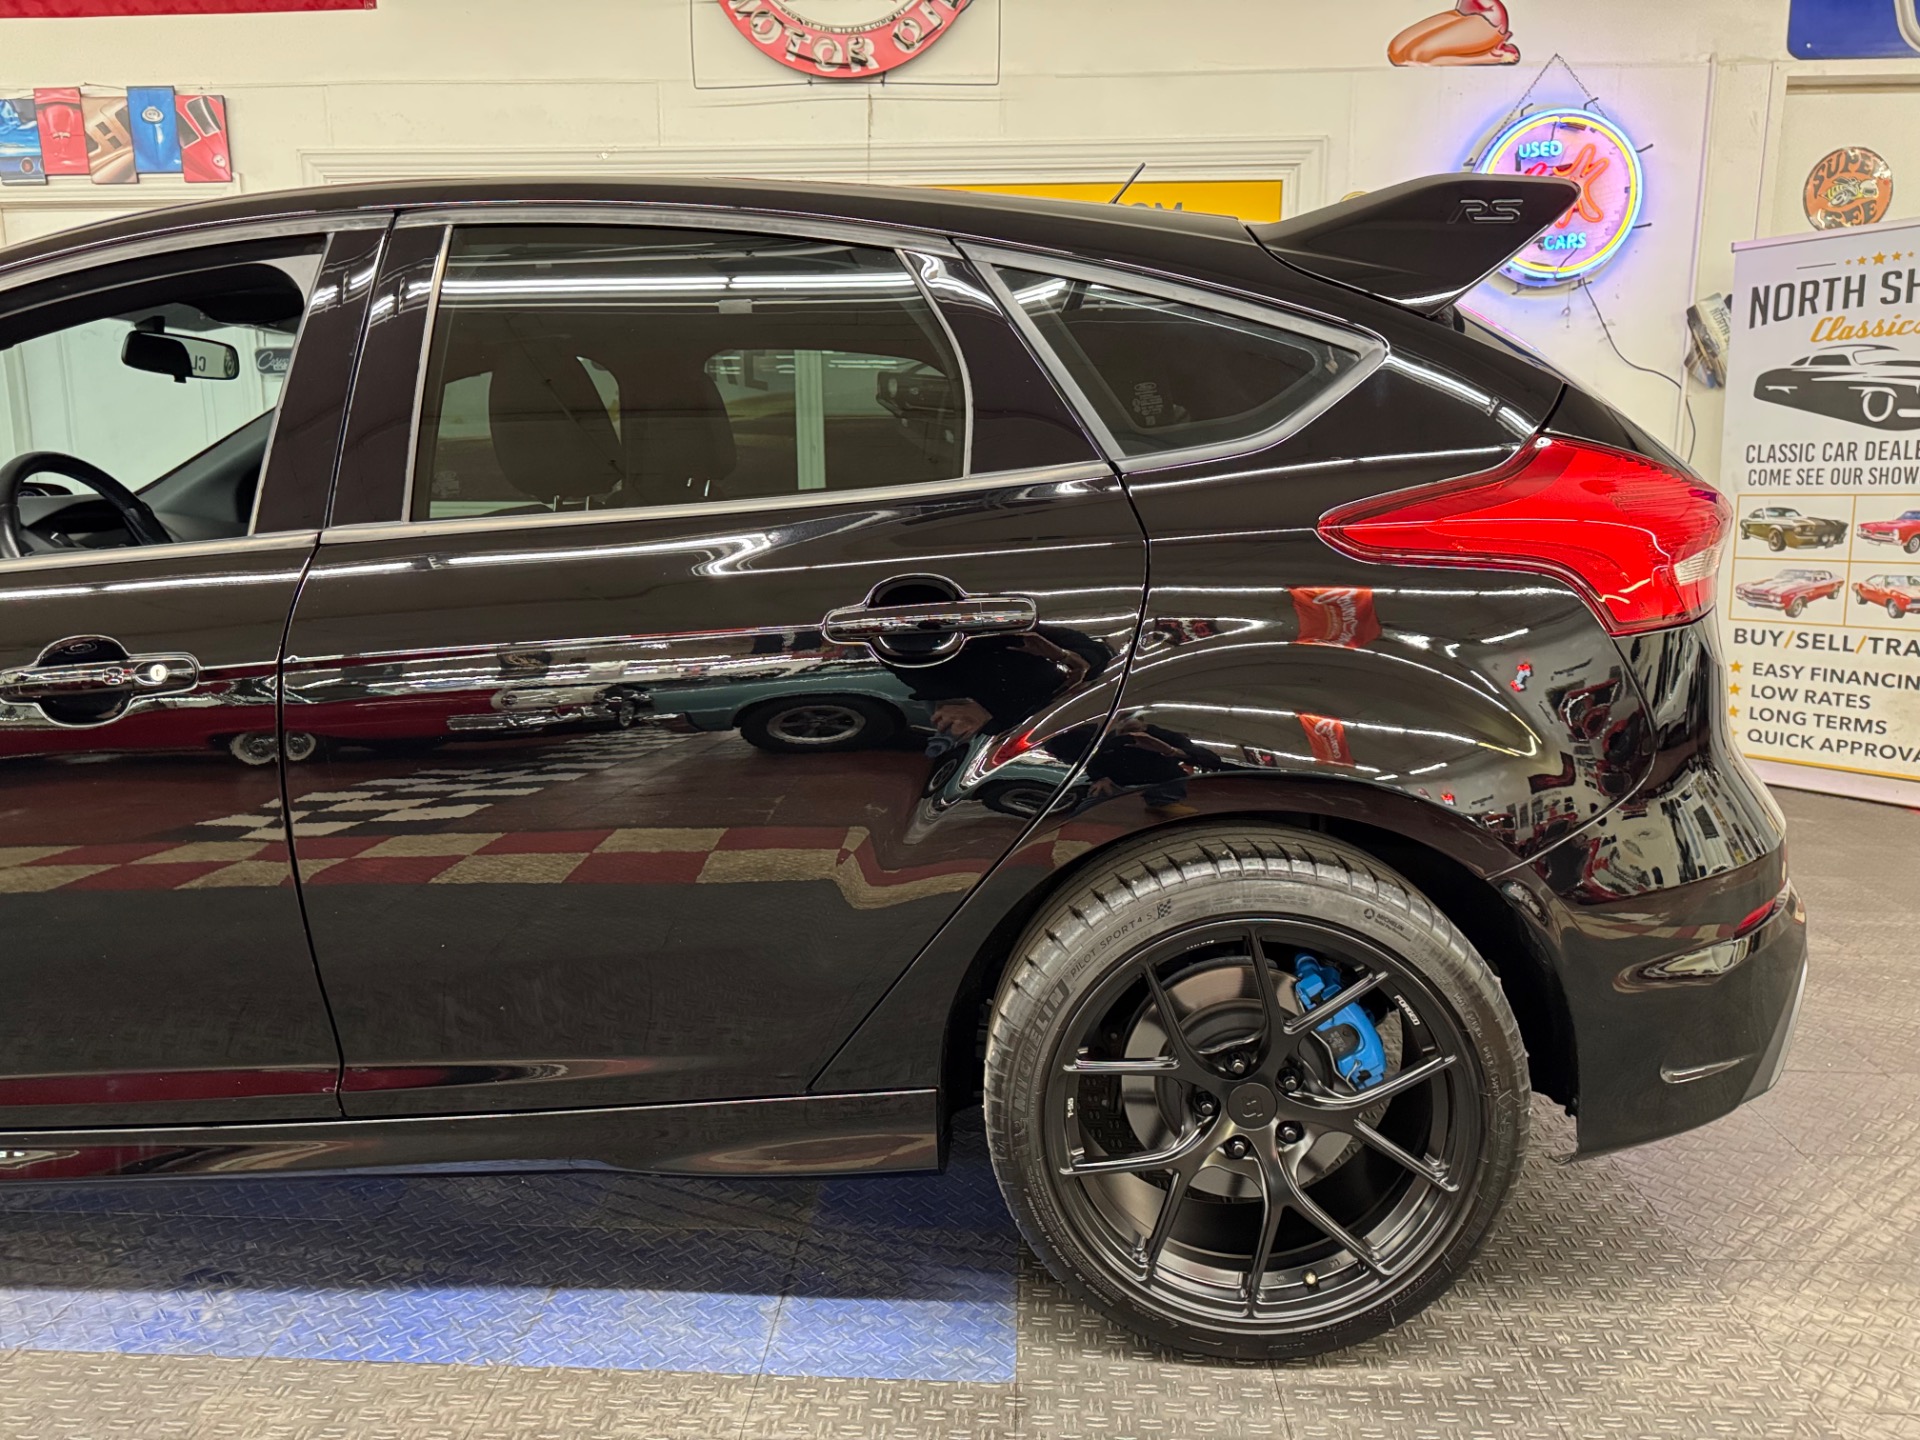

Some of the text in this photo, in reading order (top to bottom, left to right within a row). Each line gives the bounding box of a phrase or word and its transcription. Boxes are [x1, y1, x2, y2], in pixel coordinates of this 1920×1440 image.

[1517, 139, 1563, 158] USED
[1448, 199, 1524, 224] RS
[1543, 232, 1587, 250] CARS
[1749, 273, 1867, 330] NORTH
[1745, 442, 1816, 464] CLASSIC
[1822, 441, 1859, 463] CAR
[1747, 466, 1920, 487] COME SEE OUR SHOW
[1752, 661, 1920, 691] EASY FINANCIN
[1750, 684, 1872, 710] LOW RATES
[1749, 706, 1888, 735] LONG TERMS
[1747, 728, 1815, 750] QUICK
[1070, 948, 1097, 978] PILOT
[1099, 921, 1136, 950] SPORT
[1393, 994, 1421, 1026] FORGED
[1012, 977, 1071, 1114] MICHELIN
